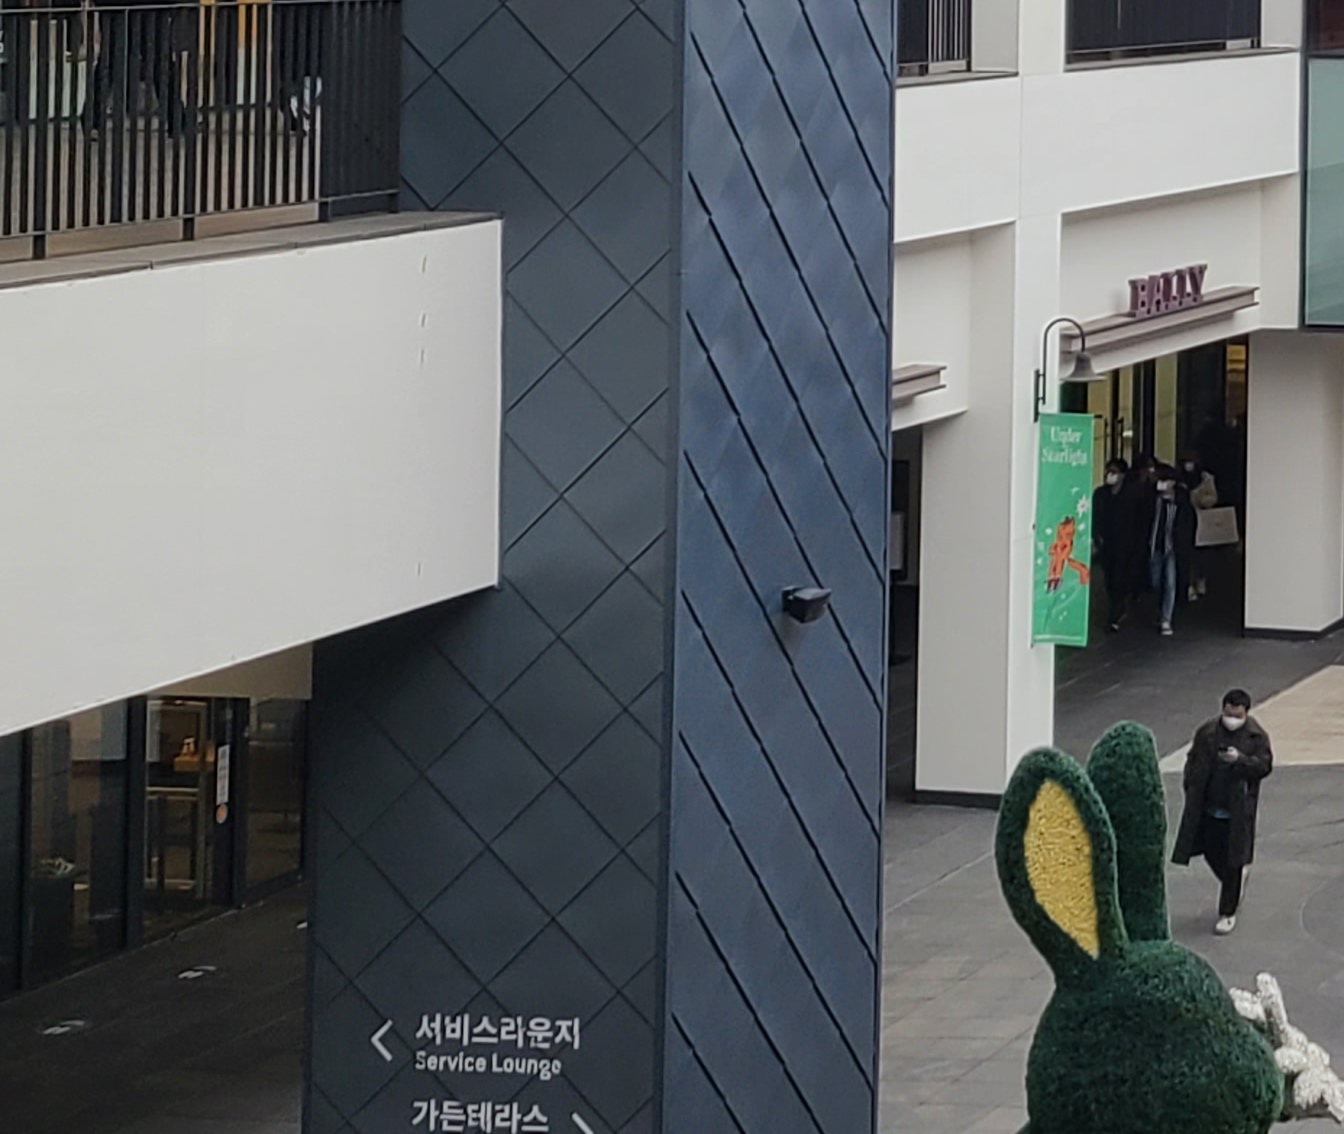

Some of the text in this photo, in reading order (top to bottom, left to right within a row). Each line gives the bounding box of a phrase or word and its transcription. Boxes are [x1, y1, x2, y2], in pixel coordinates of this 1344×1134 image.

[1127, 262, 1208, 318] BALLY
[415, 1012, 581, 1051] 서비스라운지
[415, 1050, 563, 1081] Service Lounge
[411, 1097, 550, 1134] 가든테라스
